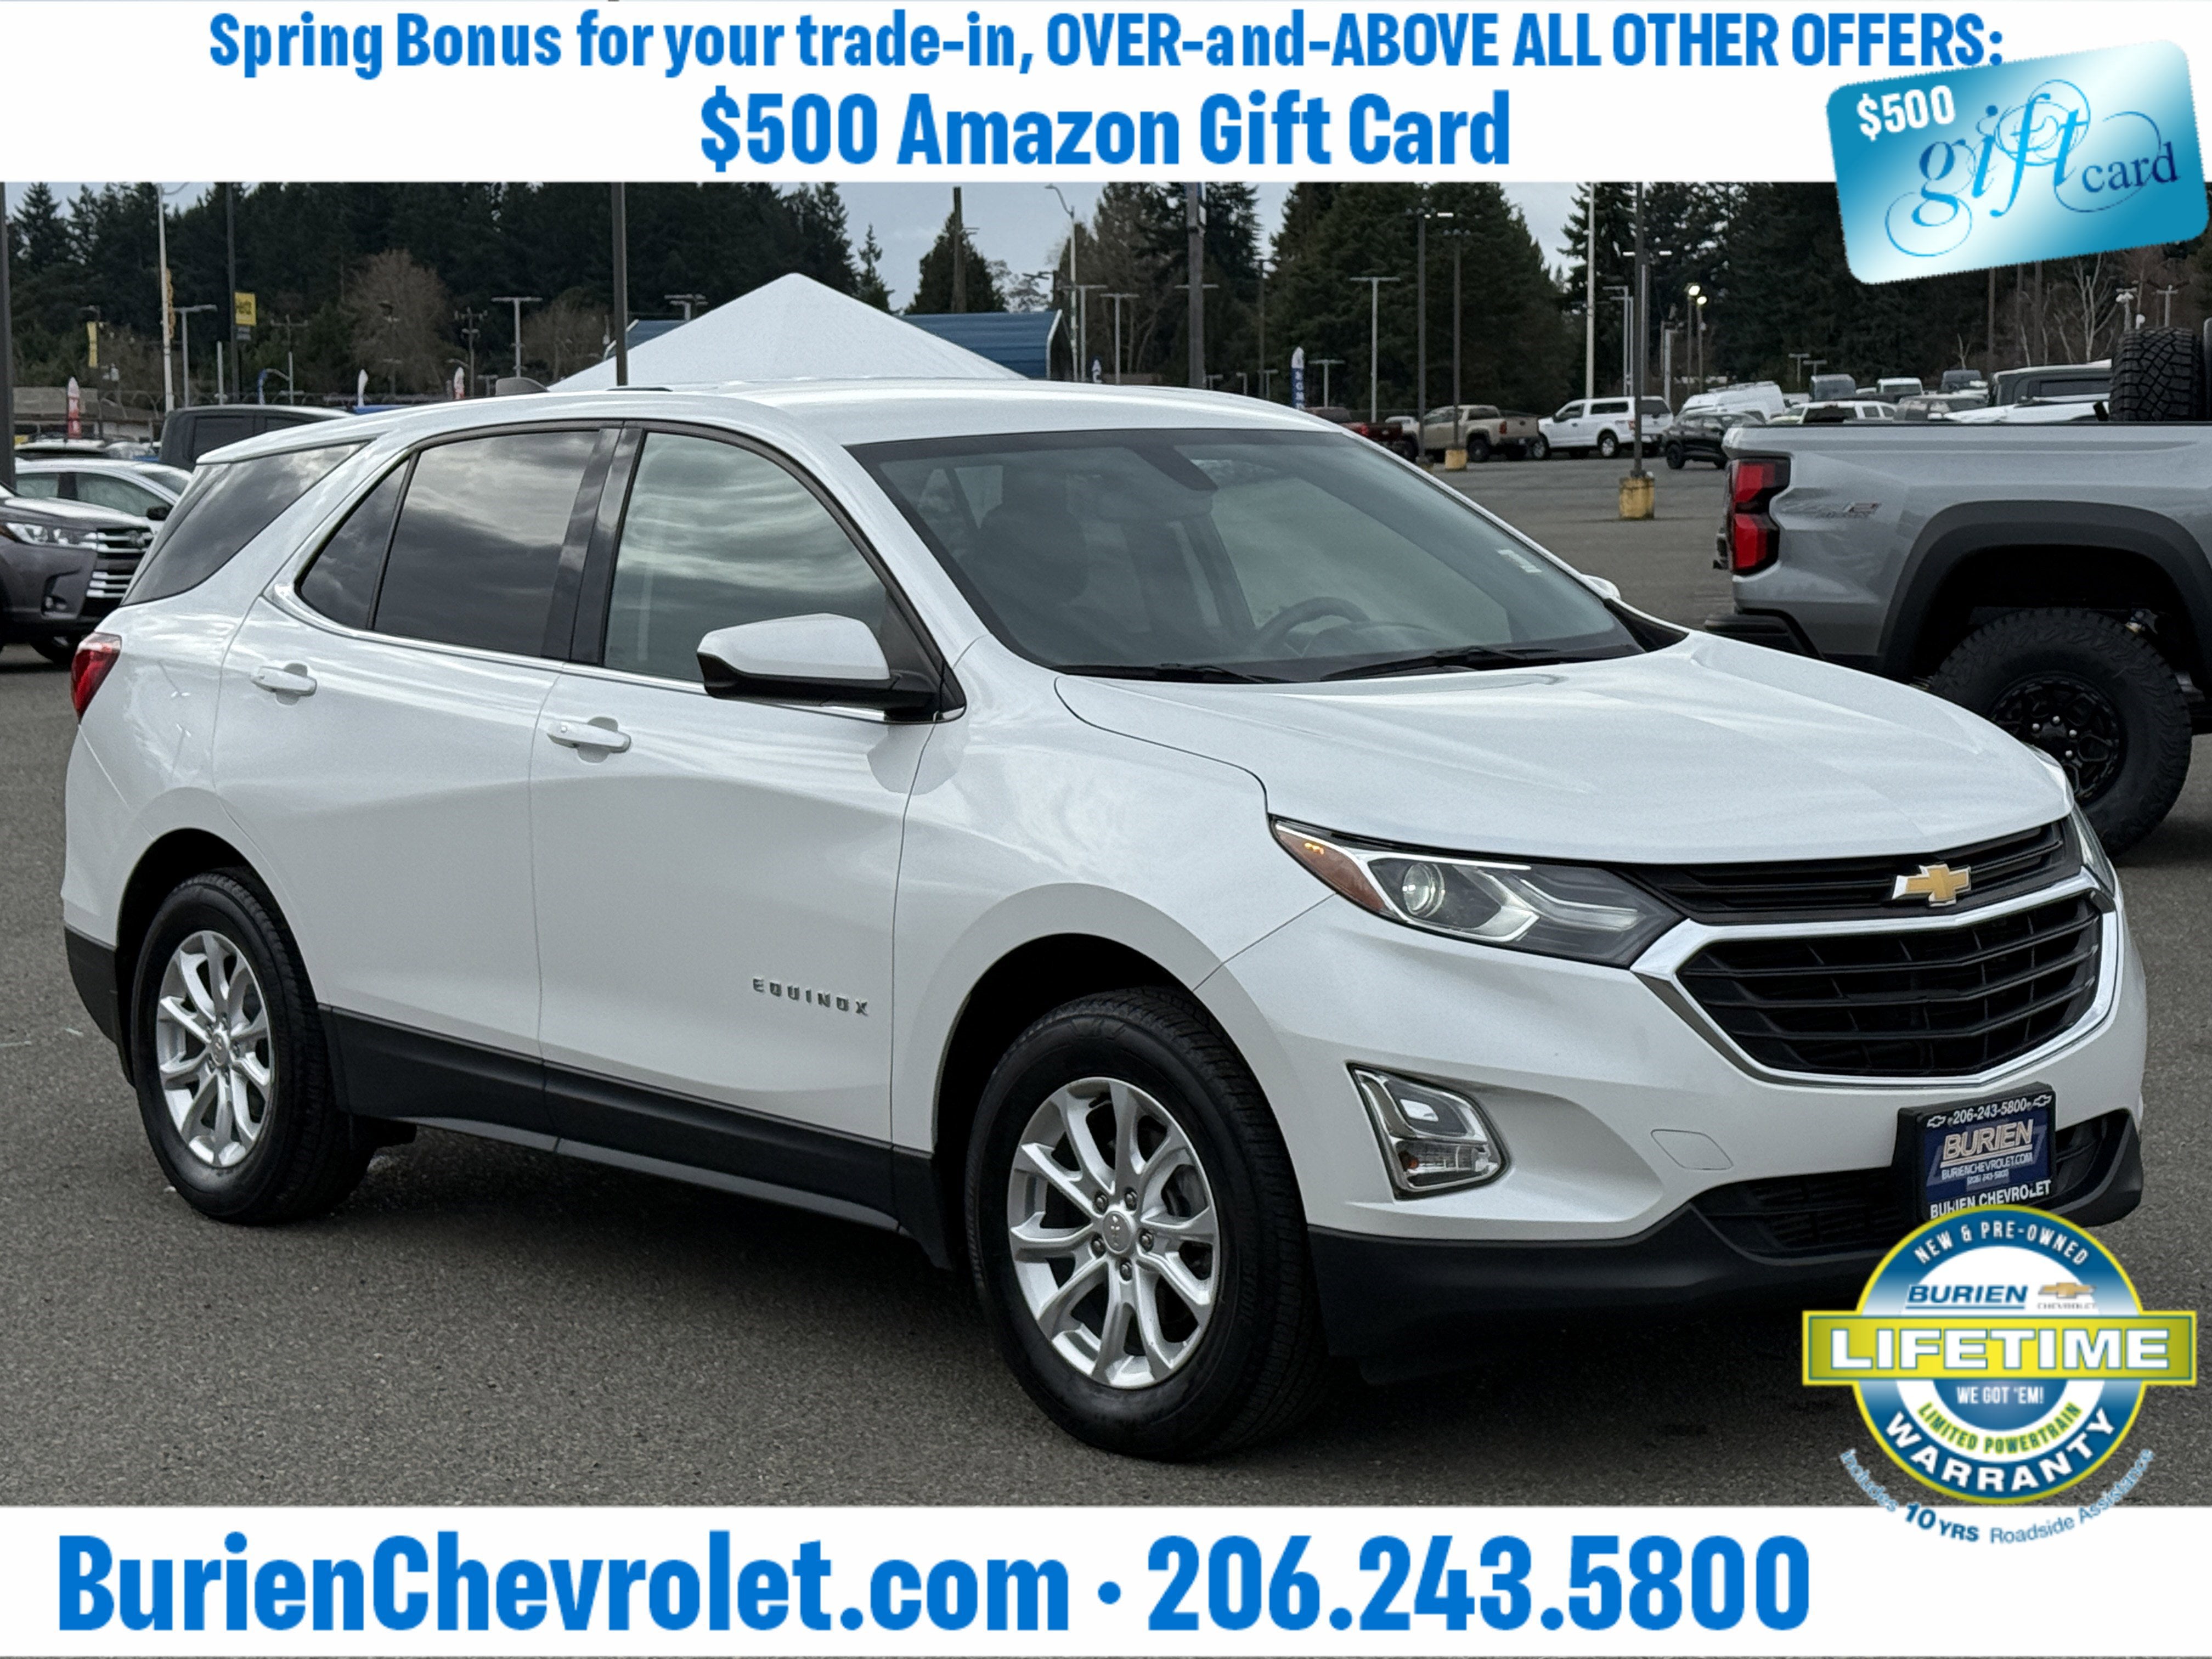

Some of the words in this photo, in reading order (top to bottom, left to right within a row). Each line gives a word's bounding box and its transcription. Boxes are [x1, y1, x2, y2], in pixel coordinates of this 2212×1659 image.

[753, 976, 868, 1016] EQUINOX
[1953, 1098, 2027, 1125] 206-243-5800
[1943, 1118, 2034, 1161] BURIEN
[1942, 1152, 2033, 1180] BURIENCHEVROLET.COM
